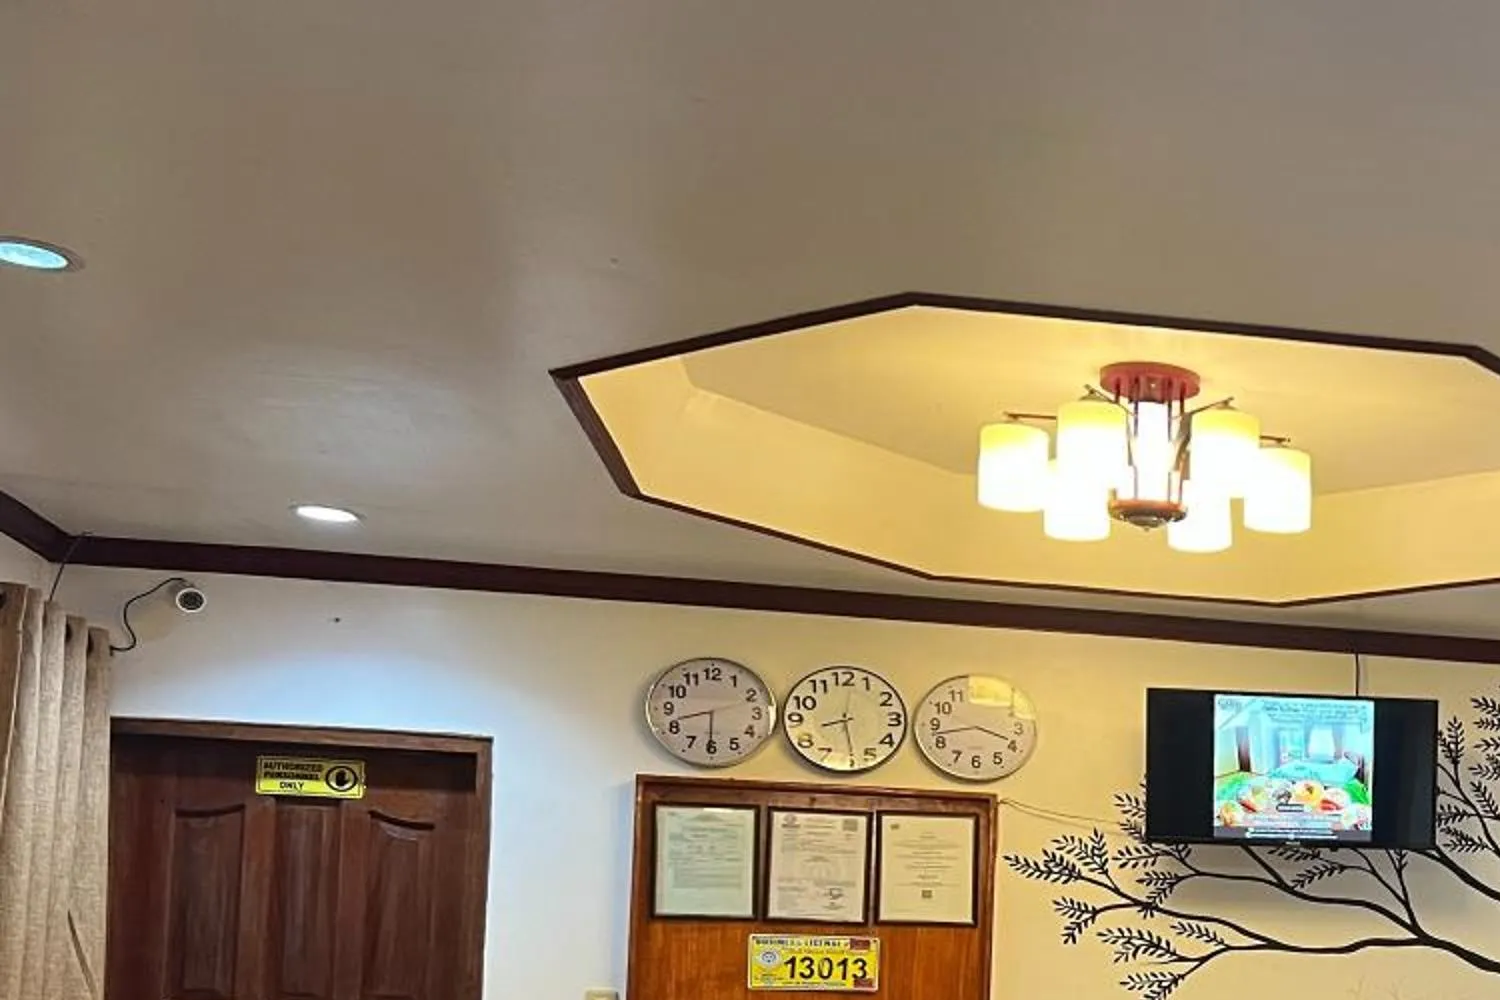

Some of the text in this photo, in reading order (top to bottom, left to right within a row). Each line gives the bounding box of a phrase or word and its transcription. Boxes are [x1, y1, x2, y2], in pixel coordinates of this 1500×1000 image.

[683, 672, 699, 686] 11
[703, 667, 722, 681] 12
[729, 674, 737, 688] 1
[832, 671, 855, 687] 12
[808, 679, 828, 694] 11
[862, 677, 870, 691] 1
[668, 685, 687, 699] 10
[745, 688, 757, 703] 2
[879, 691, 893, 706] 2
[949, 689, 963, 702] 11
[663, 701, 674, 716] 9
[793, 695, 817, 710] 10
[934, 701, 952, 715] 10
[752, 706, 762, 720] 3
[887, 712, 902, 727] 3
[669, 720, 680, 734] 8
[744, 724, 755, 738] 4
[929, 717, 940, 731] 9
[1014, 722, 1024, 736] 3
[686, 735, 697, 748] 7
[706, 740, 717, 754] 6
[729, 737, 740, 751] 5
[878, 733, 895, 748] 4
[935, 735, 946, 749] 8
[1007, 740, 1018, 753] 4
[863, 747, 877, 761] 5
[952, 750, 962, 762] 7
[992, 751, 1003, 765] 5
[971, 755, 981, 769] 6
[279, 781, 305, 790] ONLY
[783, 955, 868, 981] 13013
